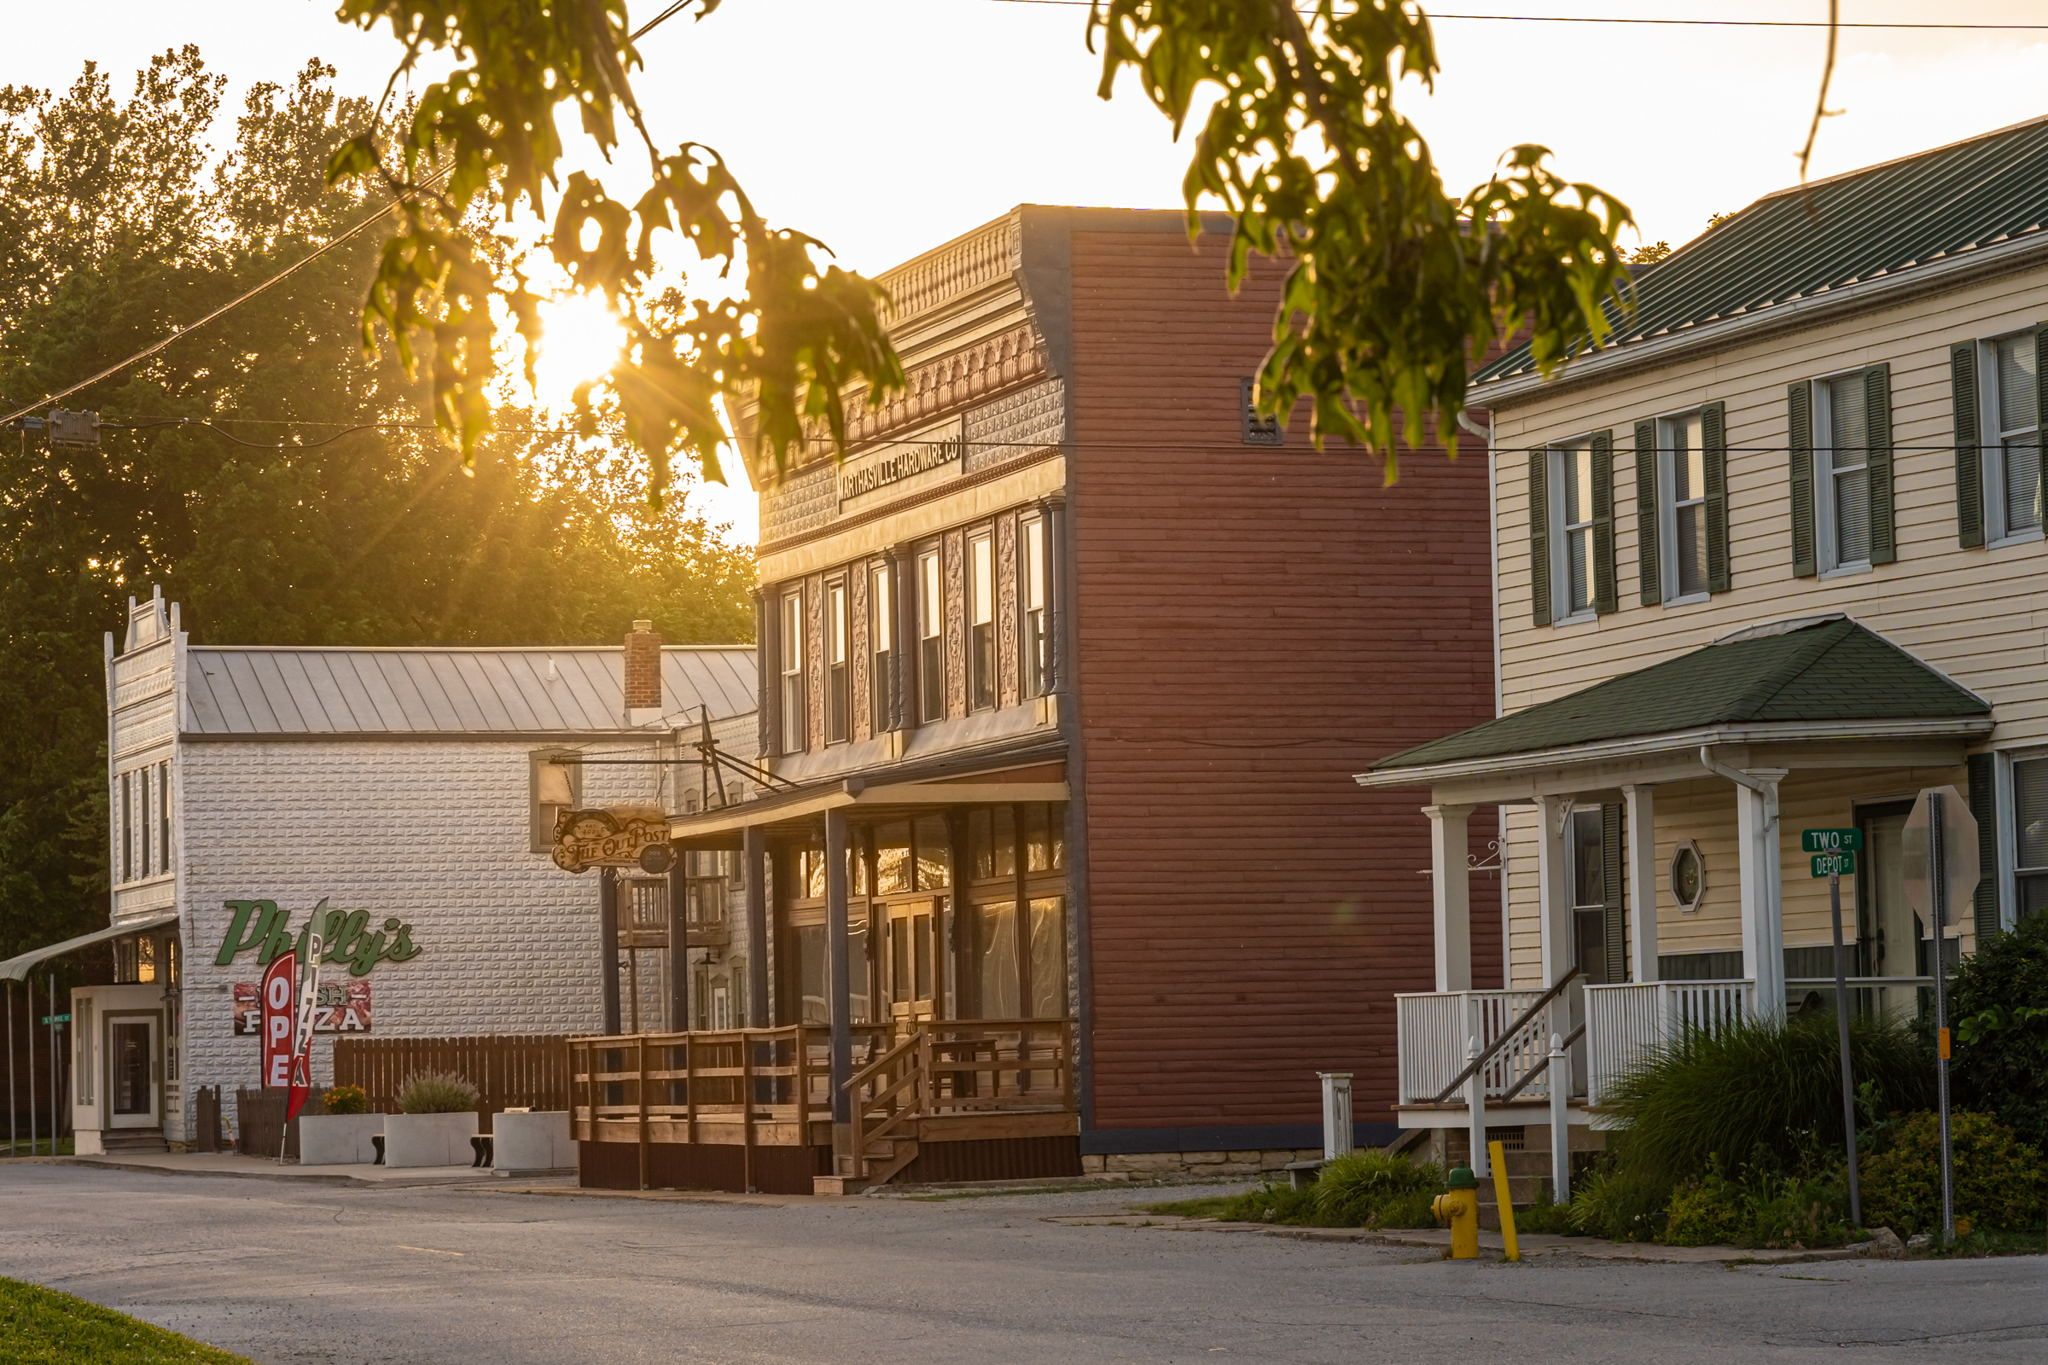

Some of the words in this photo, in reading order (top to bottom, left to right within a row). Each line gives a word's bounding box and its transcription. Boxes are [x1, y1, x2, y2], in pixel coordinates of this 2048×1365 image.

[897, 442, 944, 479] HARDWARE
[1811, 832, 1840, 849] TWO
[1843, 835, 1852, 845] ST
[566, 844, 599, 860] THE
[1816, 856, 1842, 874] DEPOT
[268, 976, 290, 1087] OPE
